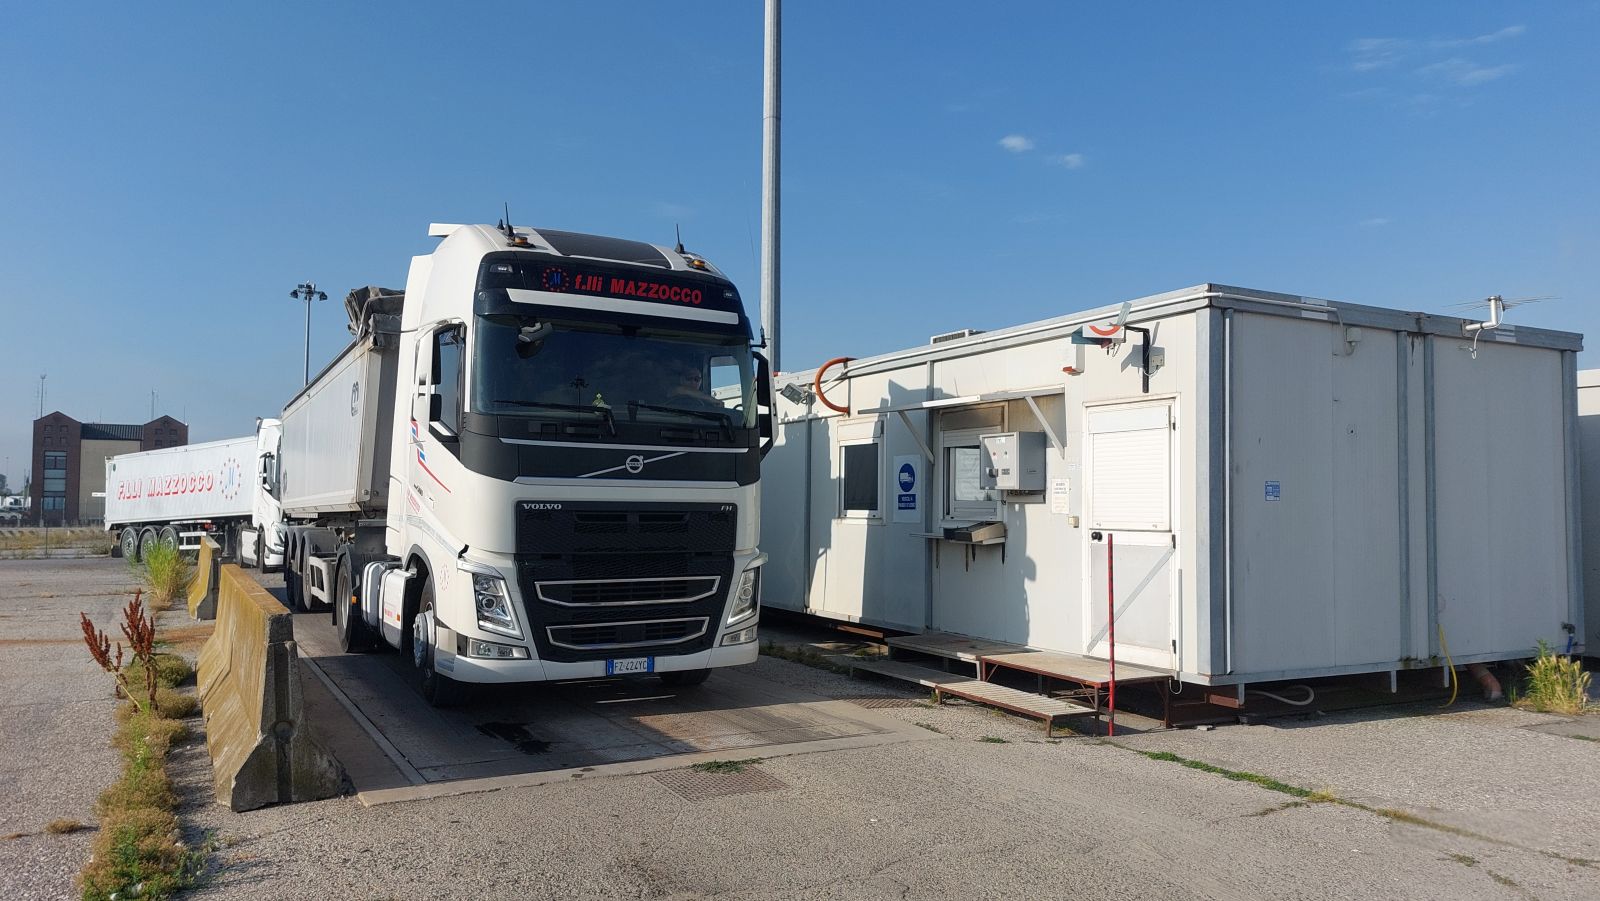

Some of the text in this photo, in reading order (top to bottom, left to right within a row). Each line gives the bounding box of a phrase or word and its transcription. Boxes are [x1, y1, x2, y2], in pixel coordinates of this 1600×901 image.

[575, 274, 602, 292] f.lli
[610, 278, 702, 304] MAZZOCCO
[147, 470, 214, 498] MAZZOCCO
